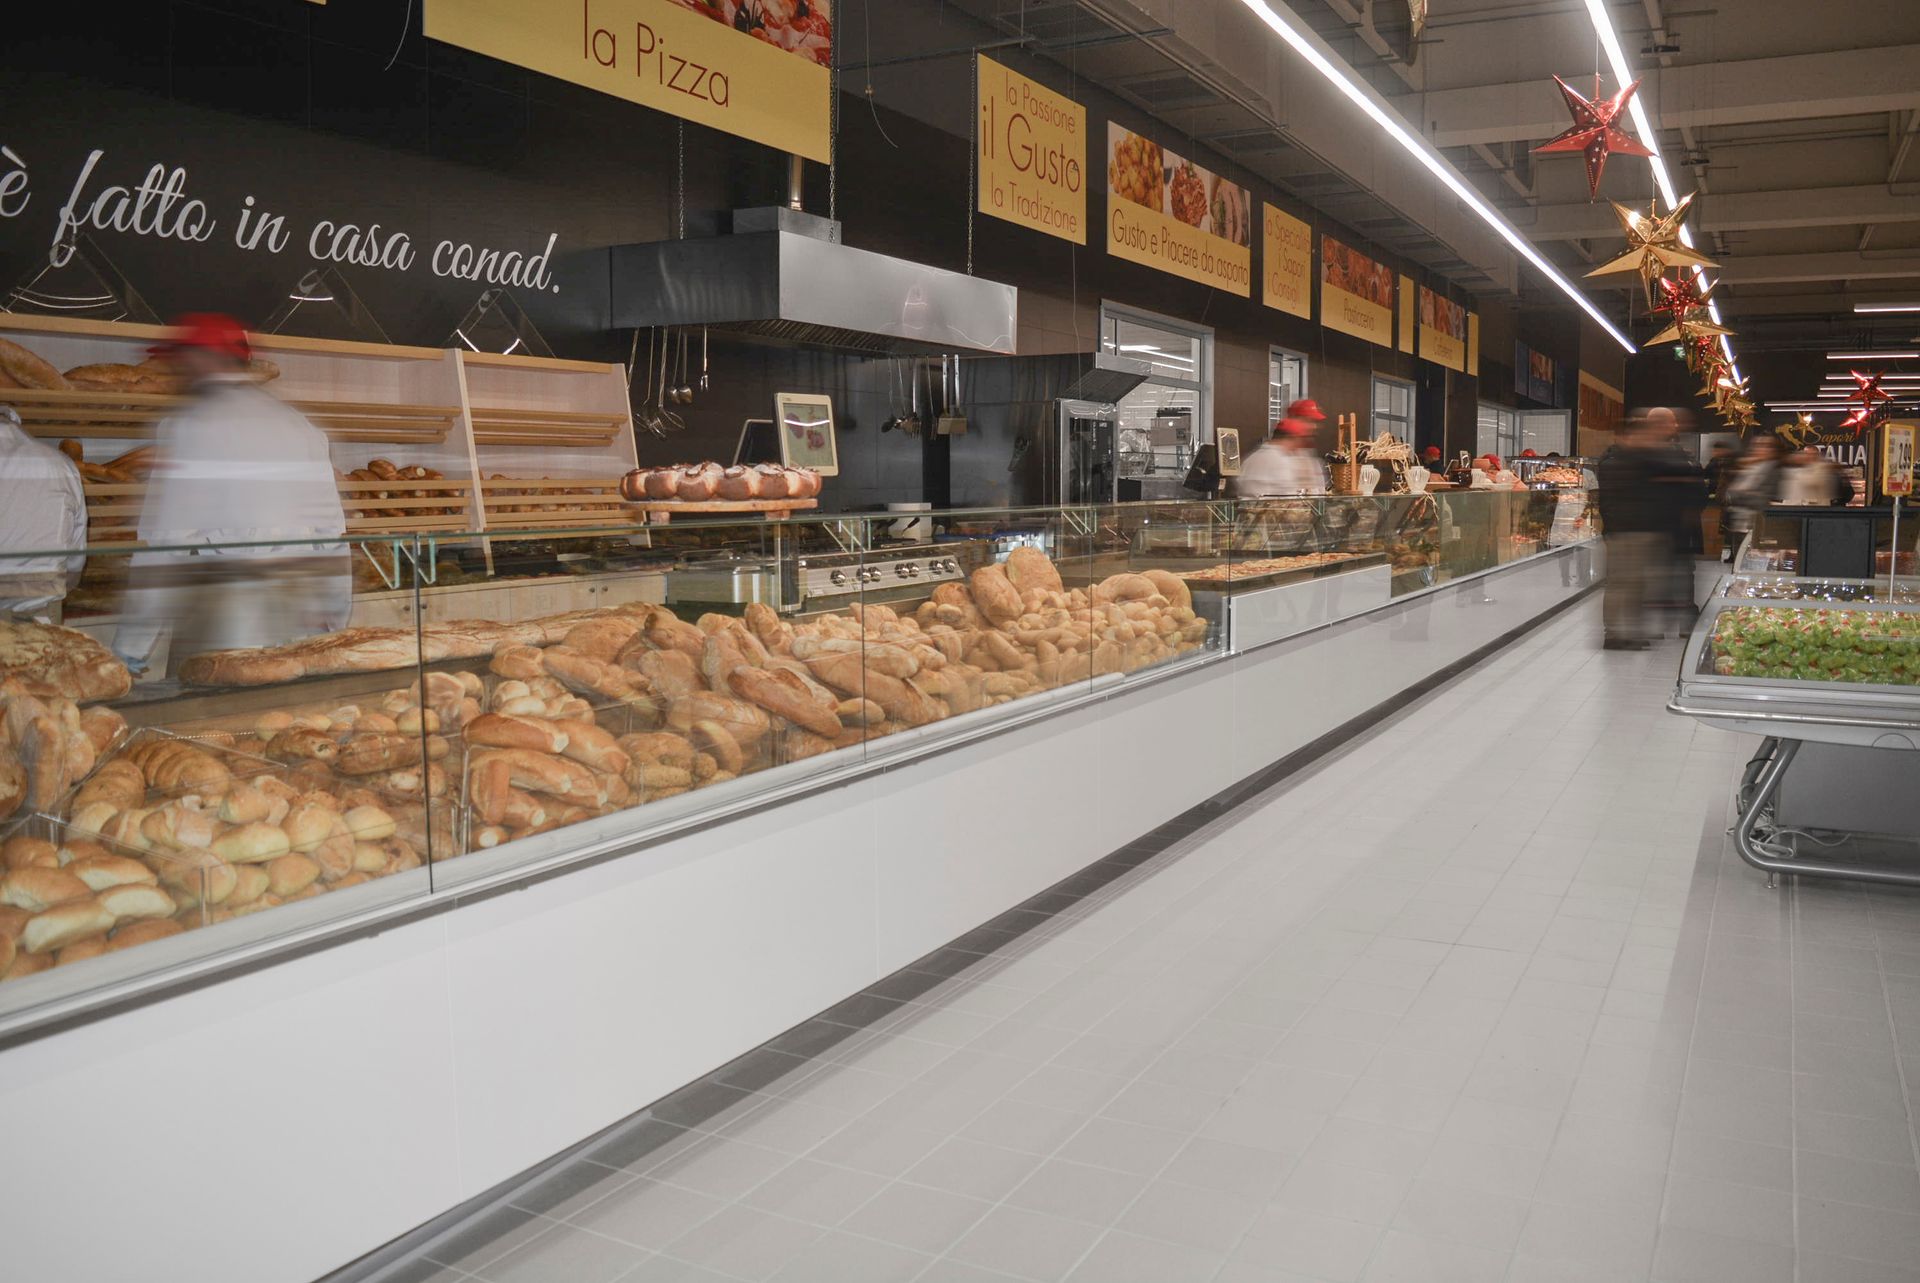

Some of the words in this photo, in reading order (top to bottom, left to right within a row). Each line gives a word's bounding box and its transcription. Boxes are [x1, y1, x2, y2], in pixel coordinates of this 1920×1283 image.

[584, 0, 616, 68] la
[637, 22, 729, 107] Pizza
[1005, 71, 1018, 106] la
[1023, 82, 1076, 134] Passione
[982, 96, 994, 159] il
[1007, 113, 1081, 193] Gusto
[0, 146, 31, 217] è
[50, 149, 216, 268] fatto
[236, 196, 290, 253] in
[309, 221, 416, 271] casa
[432, 232, 559, 293] conad.
[991, 172, 1004, 207] la
[1009, 181, 1077, 234] Tradizione
[1112, 208, 1147, 250] Gusto
[1150, 234, 1158, 255] e
[1161, 226, 1198, 268] Piacere
[1201, 240, 1214, 275] da
[1217, 258, 1249, 287] asporto
[1814, 444, 1867, 465] TALIA
